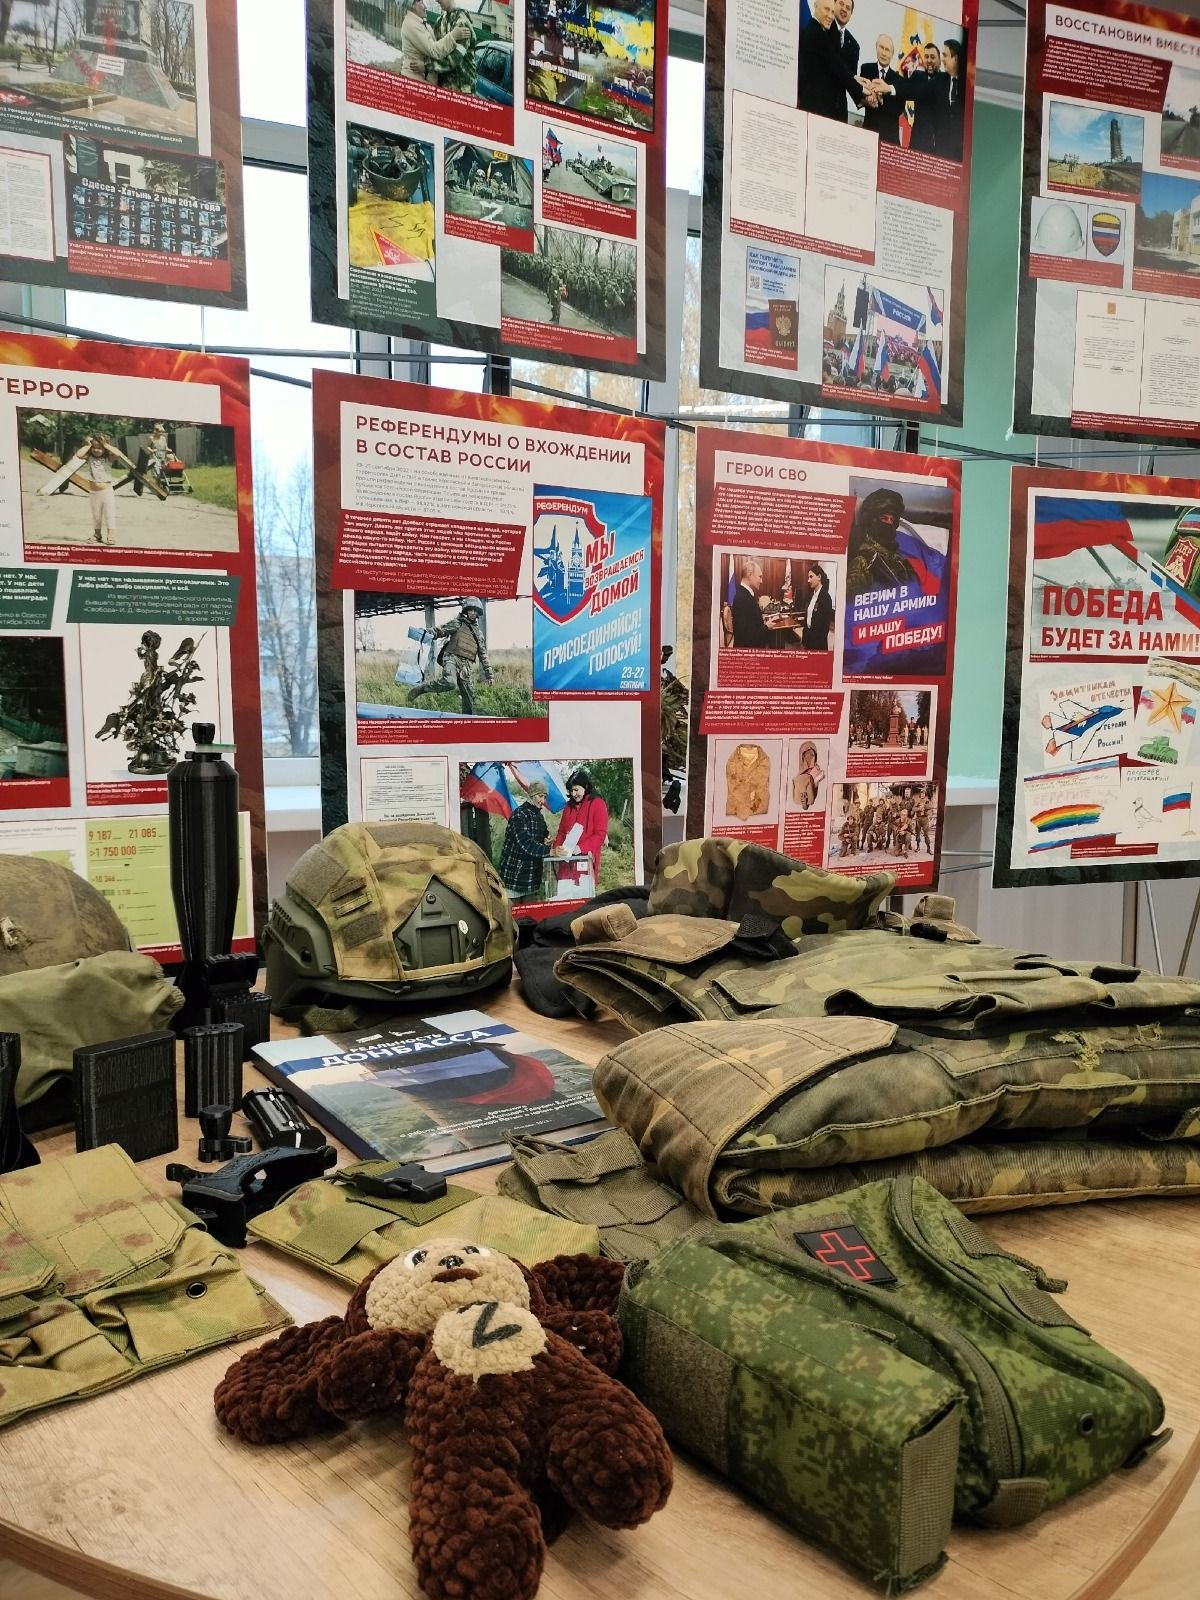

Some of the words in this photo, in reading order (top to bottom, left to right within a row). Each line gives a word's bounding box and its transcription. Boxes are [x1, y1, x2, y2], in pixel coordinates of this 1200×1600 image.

[1055, 15, 1152, 46] ВОССТАНОВИМ
[81, 177, 115, 193] Одесса
[154, 193, 159, 202] 2
[161, 195, 176, 204] мая
[178, 198, 198, 208] 2014
[199, 202, 221, 213] года
[0, 377, 90, 400] ЕРРОР
[356, 415, 501, 448] РЕФЕРЕНДУМЫ
[507, 436, 520, 449] О
[525, 438, 632, 465] ВХОЖДЕНИИ
[356, 440, 368, 454] В
[375, 441, 451, 463] СОСТАВ
[458, 451, 531, 473] РОССИИ
[726, 461, 774, 478] ГЕРОИ
[778, 468, 807, 481] СВО
[536, 502, 589, 515] РЕФЕРЕНДУМ
[585, 532, 615, 568] МЫ
[585, 550, 644, 589] ВОЗВРАЩАЕМСЯ
[590, 570, 639, 616] ДОМОЙ
[854, 588, 896, 606] ВЕРИМ
[899, 585, 908, 597] В
[1042, 585, 1163, 625] ПОБЕДА
[853, 605, 889, 621] НАШУ
[892, 595, 937, 613] АРМИЮ
[543, 608, 642, 672] ПРИСОЕДИНЯЙСЯ!
[858, 628, 866, 639] И
[869, 620, 902, 637] НАШУ
[885, 625, 943, 649] ПОБЕДУ!
[1042, 626, 1104, 651] БУДЕТ
[1108, 630, 1133, 650] ЗА
[1138, 631, 1200, 652] НАМИ!
[589, 633, 641, 676] ГОЛОСУЙ!
[621, 667, 645, 679] 23-27
[97, 830, 112, 840] 187
[129, 828, 138, 838] 21
[141, 828, 157, 838] 085
[103, 847, 119, 857] 750
[121, 846, 137, 856] 000
[321, 1030, 492, 1067] ДОНБАССА
[457, 1300, 523, 1349] Z
